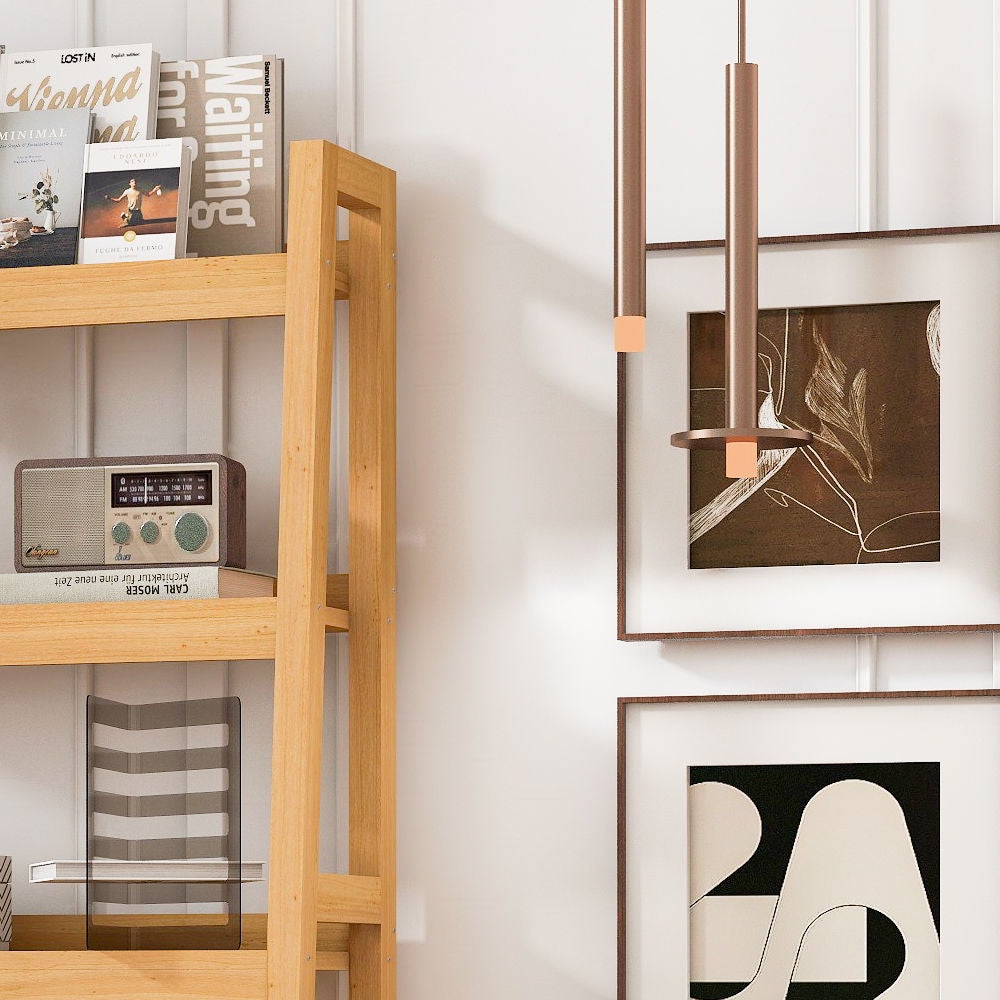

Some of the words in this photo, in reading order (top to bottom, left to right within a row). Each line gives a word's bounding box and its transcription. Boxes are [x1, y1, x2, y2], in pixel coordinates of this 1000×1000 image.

[61, 53, 83, 64] LOST
[6, 66, 142, 111] Vienna
[158, 60, 199, 127] for
[188, 55, 264, 230] Waiting
[54, 577, 72, 587] Zeit
[75, 576, 97, 584] neue
[99, 575, 119, 585] eine
[122, 574, 135, 585] für
[137, 572, 190, 584] Architektur
[126, 585, 160, 595] MOSER
[164, 584, 189, 594] CARL
